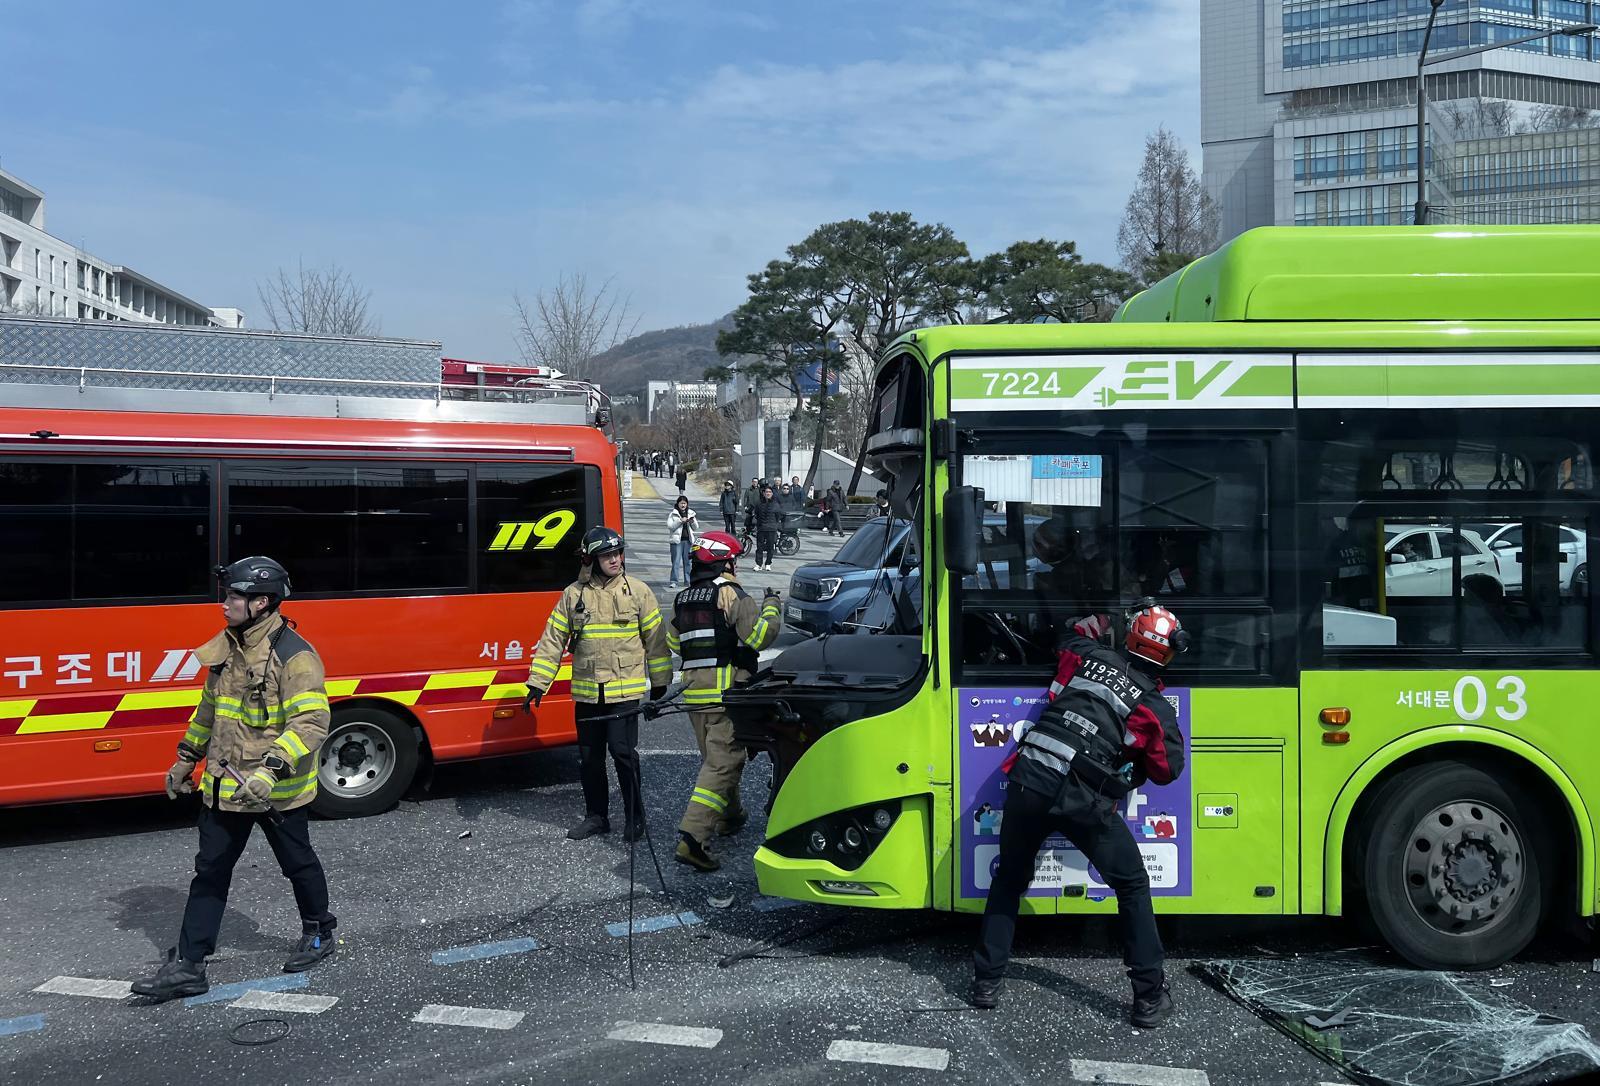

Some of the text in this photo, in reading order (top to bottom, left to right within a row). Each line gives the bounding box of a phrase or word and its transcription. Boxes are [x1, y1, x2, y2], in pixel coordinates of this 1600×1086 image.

[981, 371, 1061, 396] 7224
[1120, 360, 1233, 401] EV
[487, 509, 577, 552] 119
[4, 648, 201, 688] 구조대 11
[1082, 658, 1143, 700] 119구조대
[1083, 670, 1127, 699] RESCUE
[1395, 675, 1528, 722] 서대문 03
